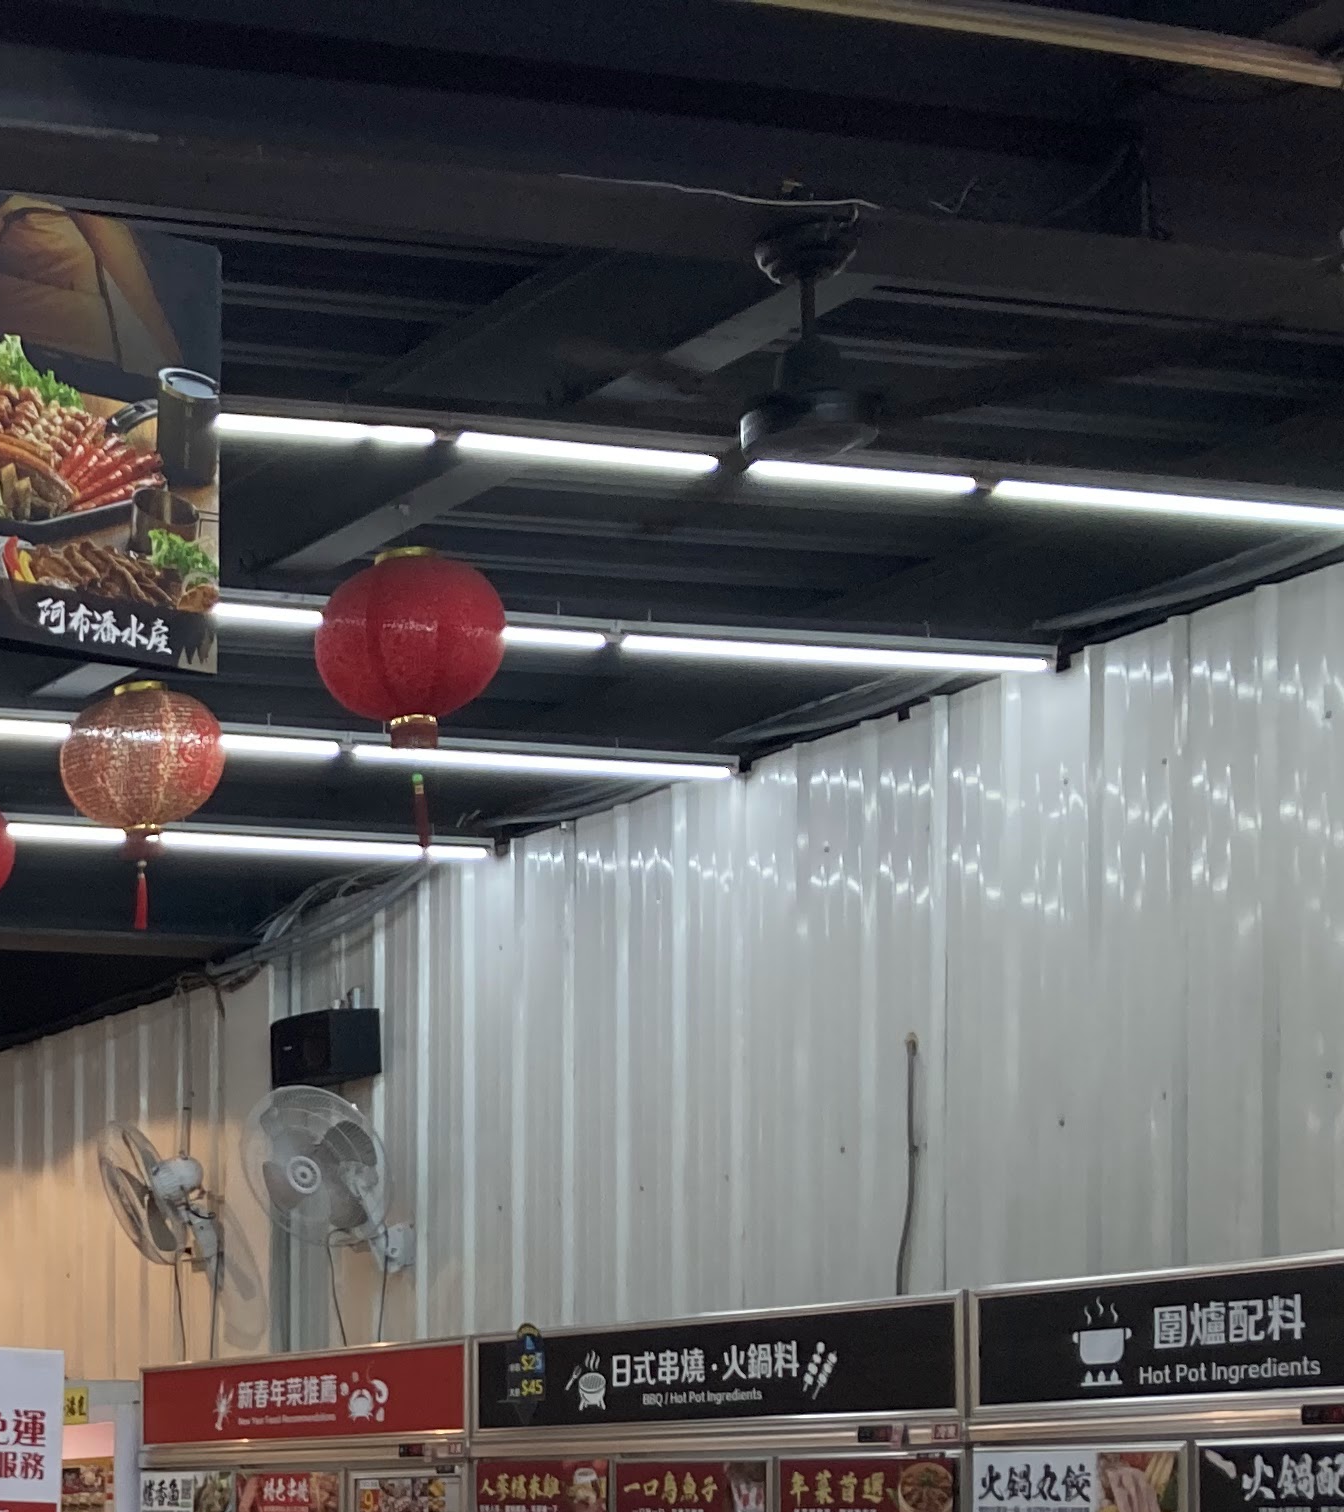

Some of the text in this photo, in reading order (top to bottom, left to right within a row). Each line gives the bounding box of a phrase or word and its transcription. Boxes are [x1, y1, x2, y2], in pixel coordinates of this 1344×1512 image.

[1153, 1293, 1307, 1350] 圍爐配料
[1138, 1355, 1322, 1386] Hot Pot Ingredients
[236, 1374, 338, 1409] 新春年菜推薦
[670, 1390, 686, 1404] Hot
[688, 1390, 705, 1403] Pot
[706, 1387, 764, 1405] Ingredients
[977, 1462, 1093, 1503] 火鍋丸餃
